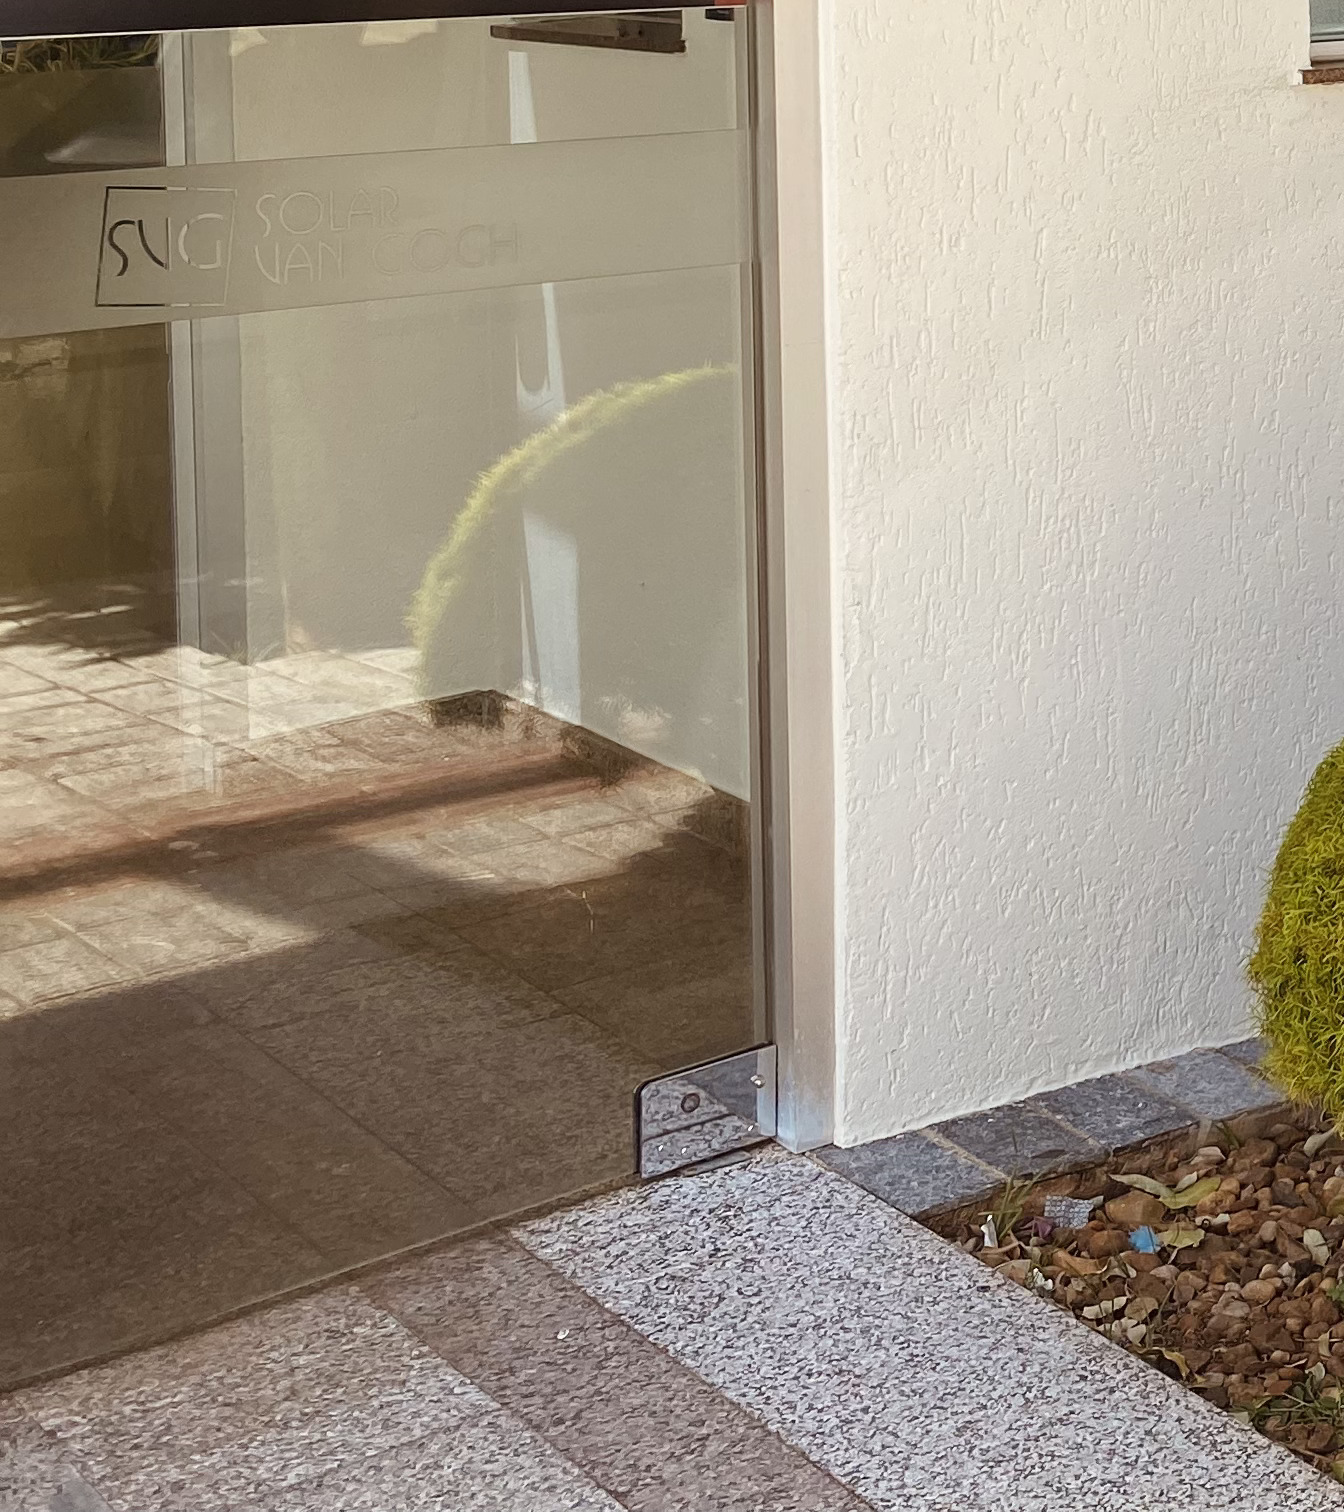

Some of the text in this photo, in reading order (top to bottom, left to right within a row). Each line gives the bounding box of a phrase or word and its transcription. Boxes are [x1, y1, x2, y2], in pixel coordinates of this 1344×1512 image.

[255, 186, 400, 238] SOLAR
[108, 213, 224, 277] SVG
[253, 238, 345, 285] VAN
